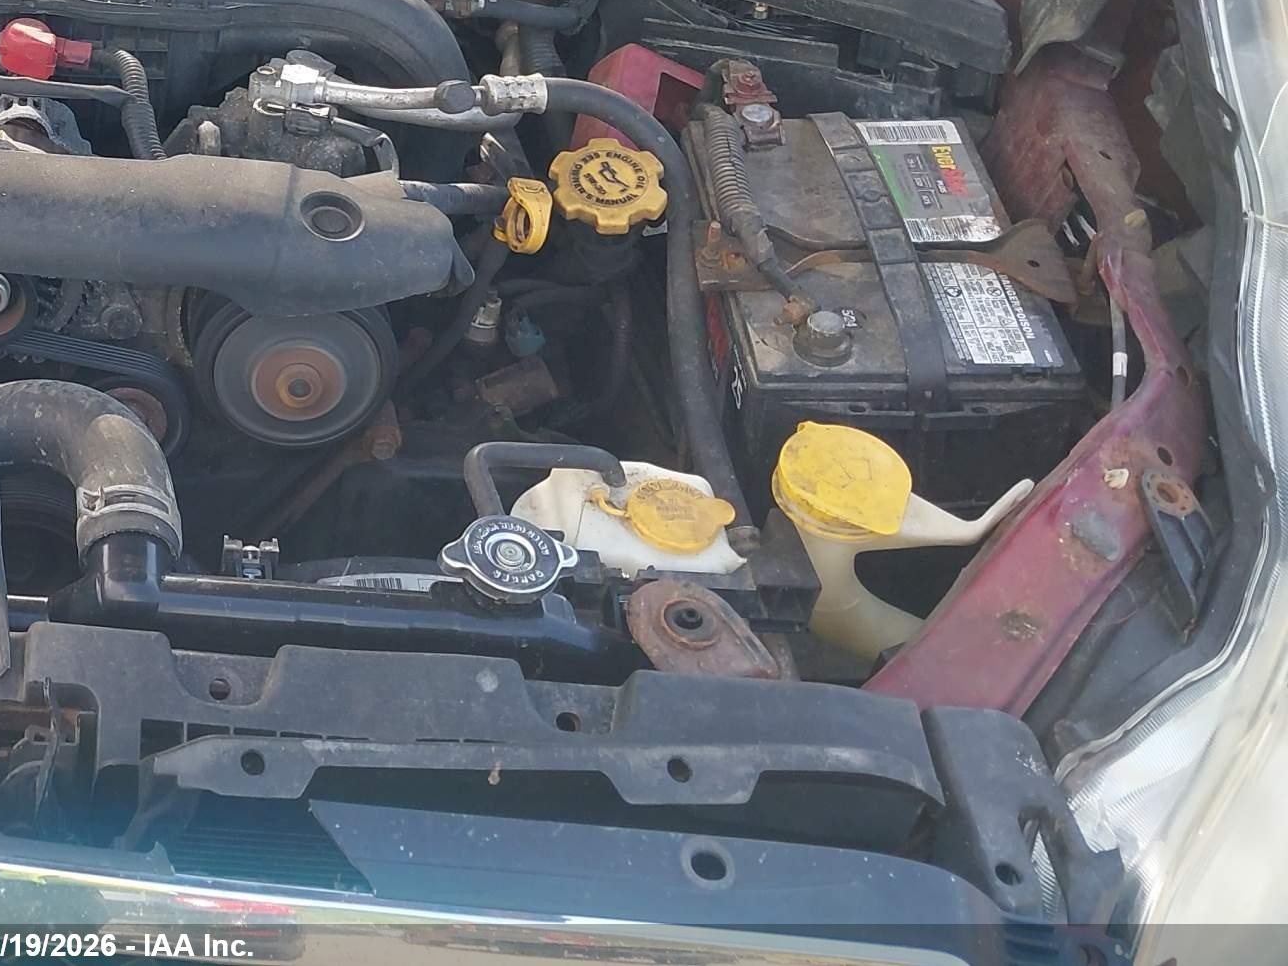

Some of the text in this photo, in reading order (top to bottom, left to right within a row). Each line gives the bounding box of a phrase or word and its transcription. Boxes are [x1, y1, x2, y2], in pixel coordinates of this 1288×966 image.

[581, 151, 601, 165] SEE
[595, 193, 639, 205] MANUAL
[605, 151, 646, 189] ENGINE OIL
